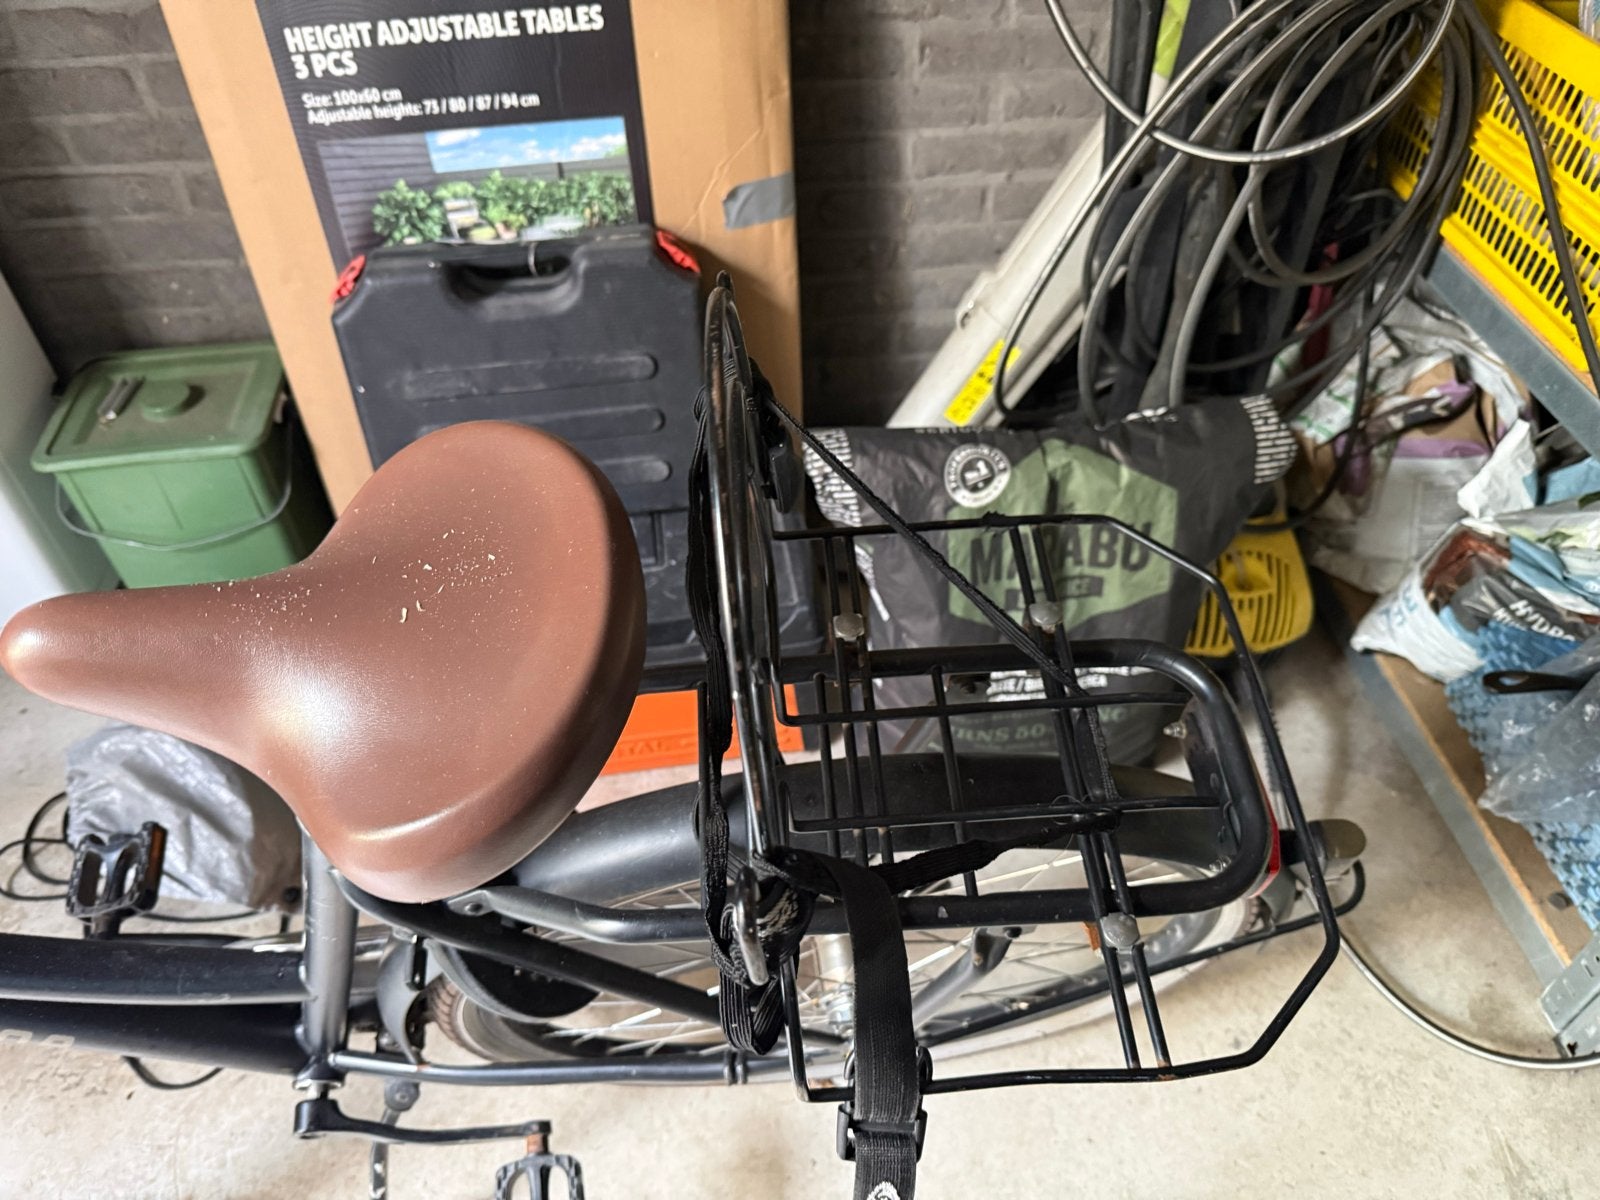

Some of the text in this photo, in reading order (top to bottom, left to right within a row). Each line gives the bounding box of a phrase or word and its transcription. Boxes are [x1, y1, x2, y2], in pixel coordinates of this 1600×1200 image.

[283, 4, 605, 53] HEIGHT ADJUSTABLE TABLES
[291, 51, 358, 79] 3 PCS
[302, 87, 403, 108] Size: 100x60 cm
[307, 105, 373, 126] Adjustable
[372, 102, 423, 121] heights:
[519, 93, 541, 108] cm
